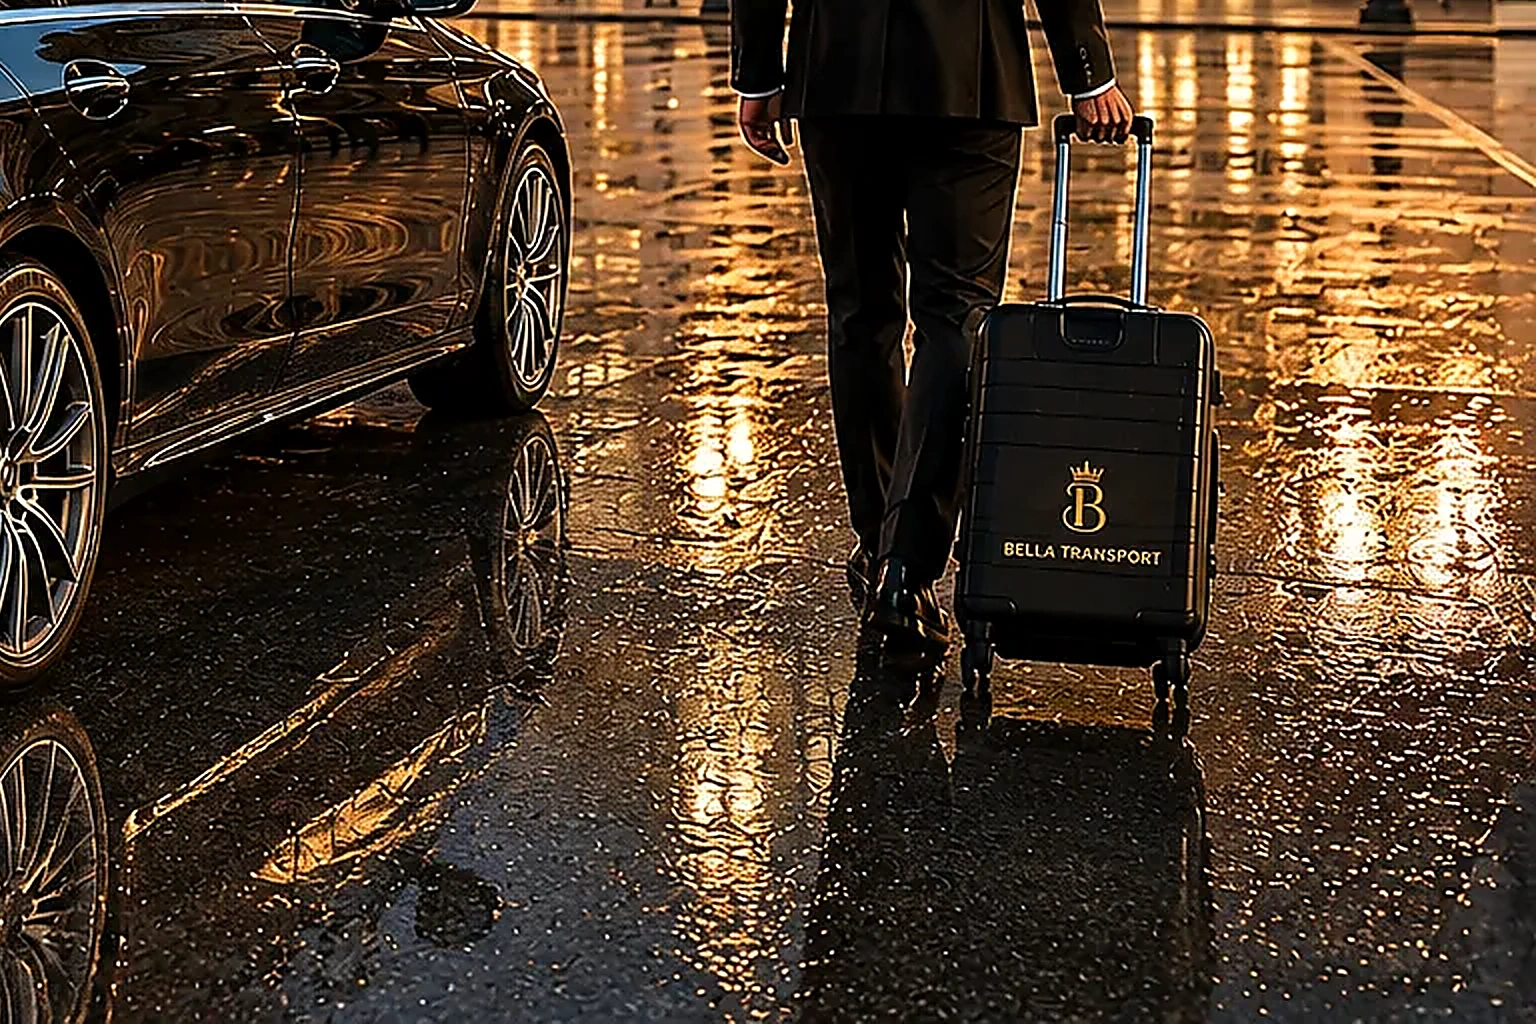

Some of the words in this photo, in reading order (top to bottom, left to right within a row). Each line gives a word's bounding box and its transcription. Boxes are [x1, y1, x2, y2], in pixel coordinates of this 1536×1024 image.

[1062, 482, 1107, 534] B
[1003, 541, 1056, 559] BELLA
[1060, 544, 1162, 566] TRANSPORT
